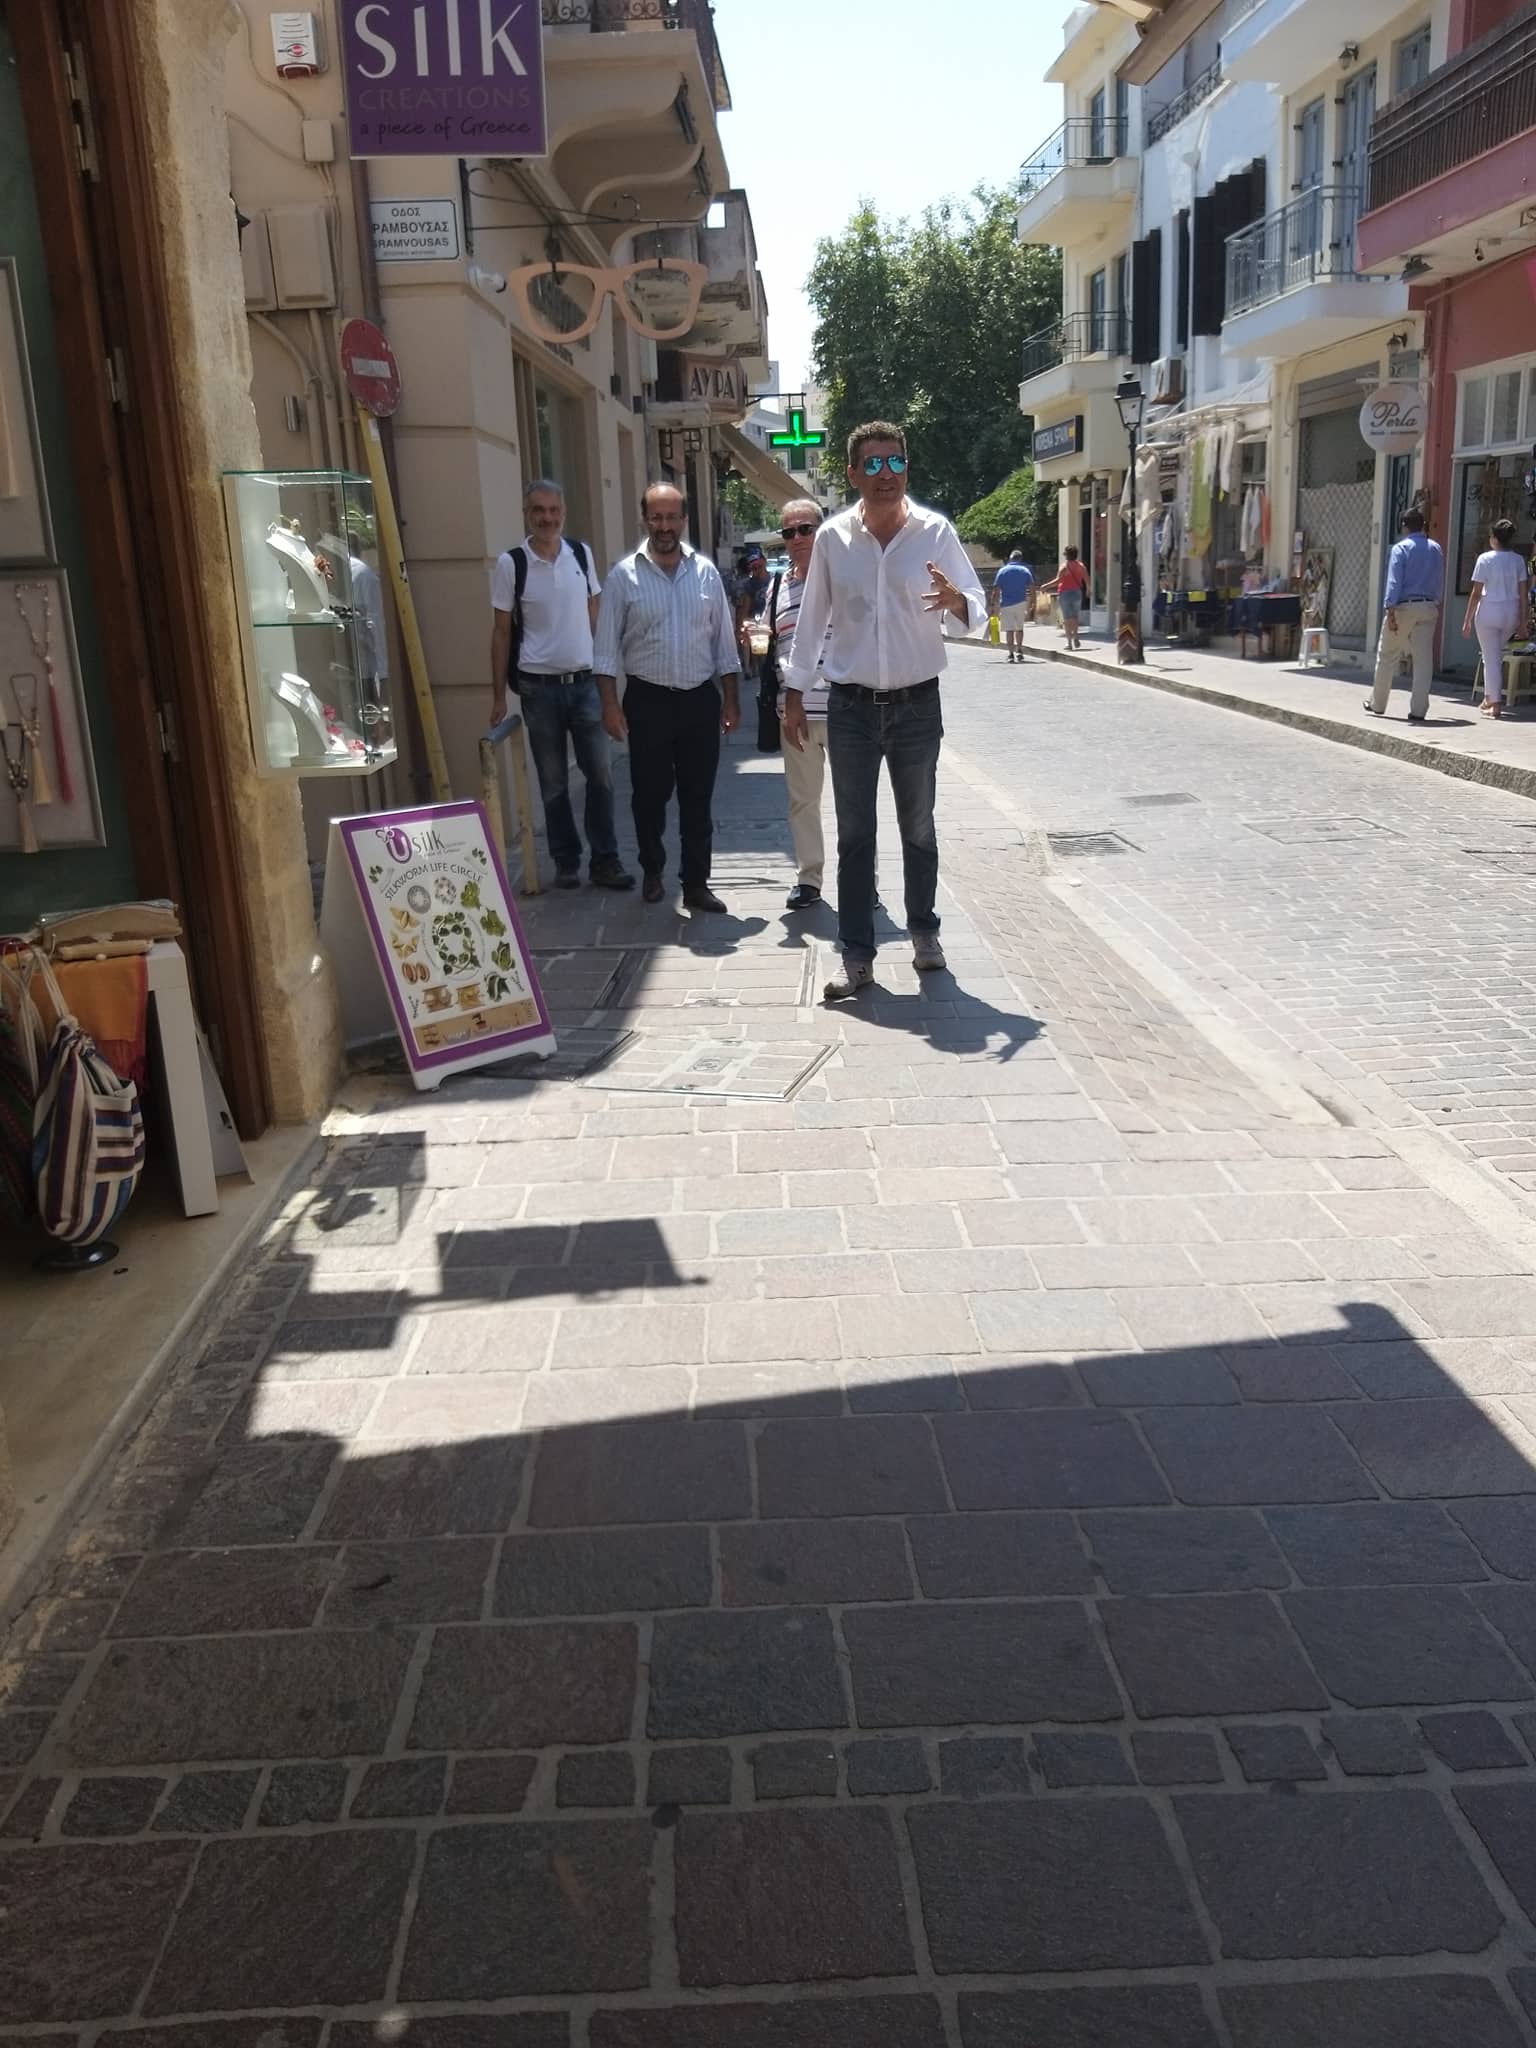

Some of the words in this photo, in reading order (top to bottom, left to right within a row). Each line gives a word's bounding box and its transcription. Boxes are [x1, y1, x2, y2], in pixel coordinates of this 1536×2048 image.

[354, 0, 528, 79] silk
[359, 86, 531, 111] CREATIONS
[359, 122, 370, 136] a
[379, 119, 425, 144] piece
[434, 116, 452, 141] of
[460, 116, 531, 137] Greece
[391, 207, 421, 217] ΟΔΟΣ
[372, 221, 449, 234] ΡΑΜΒΟΥΣΑΣ
[1370, 401, 1420, 428] Perla
[412, 829, 445, 854] silk
[384, 864, 429, 902] SILKWORM
[430, 862, 448, 873] LIFE
[450, 864, 484, 882] CIRCLE
